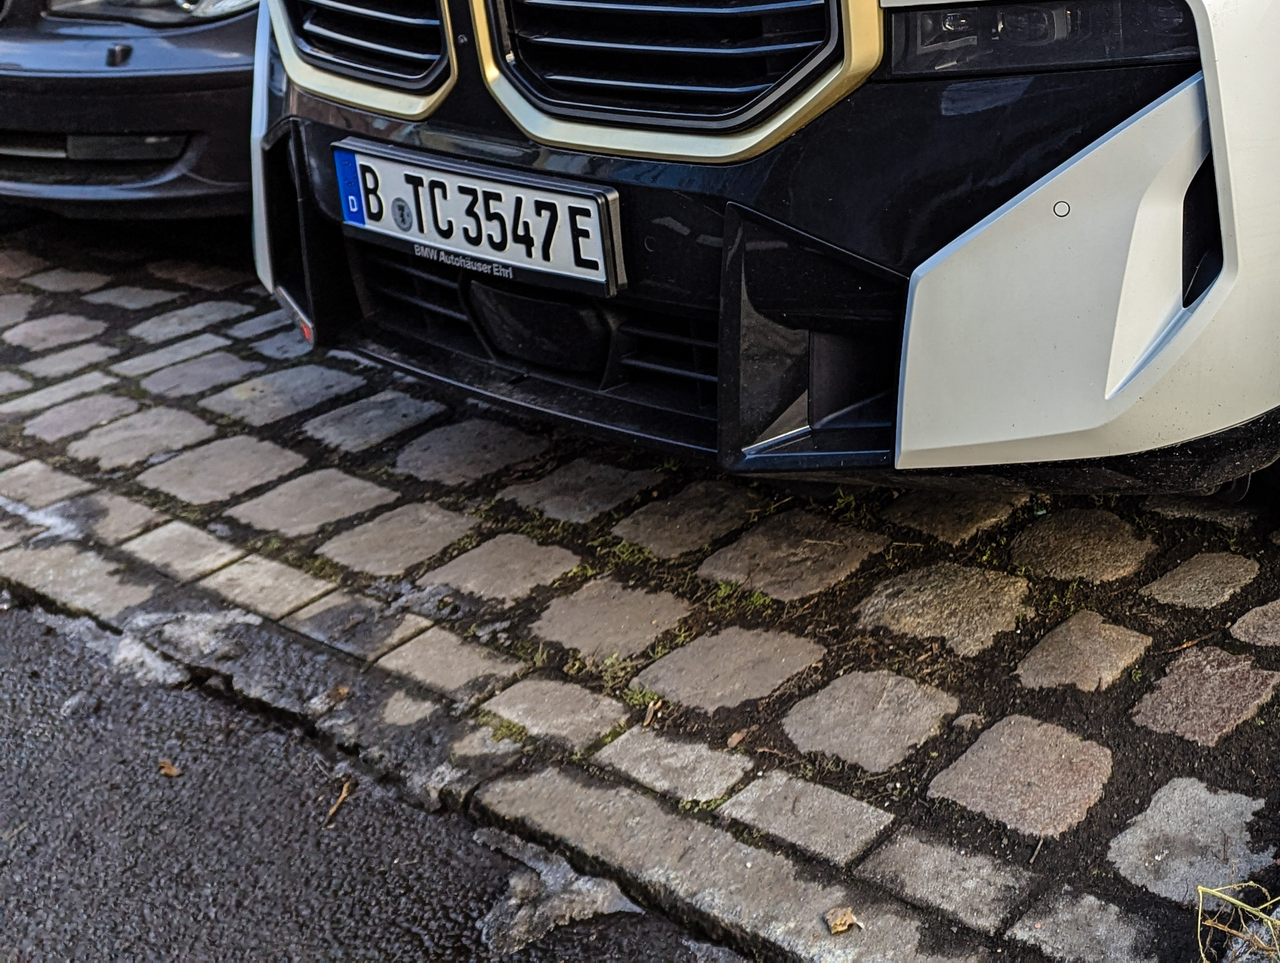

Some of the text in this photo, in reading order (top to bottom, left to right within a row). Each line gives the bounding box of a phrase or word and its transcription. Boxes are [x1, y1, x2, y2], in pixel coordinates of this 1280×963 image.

[349, 195, 358, 213] D
[359, 163, 384, 223] B
[414, 244, 513, 279] BMW Autohäuser Ehrl
